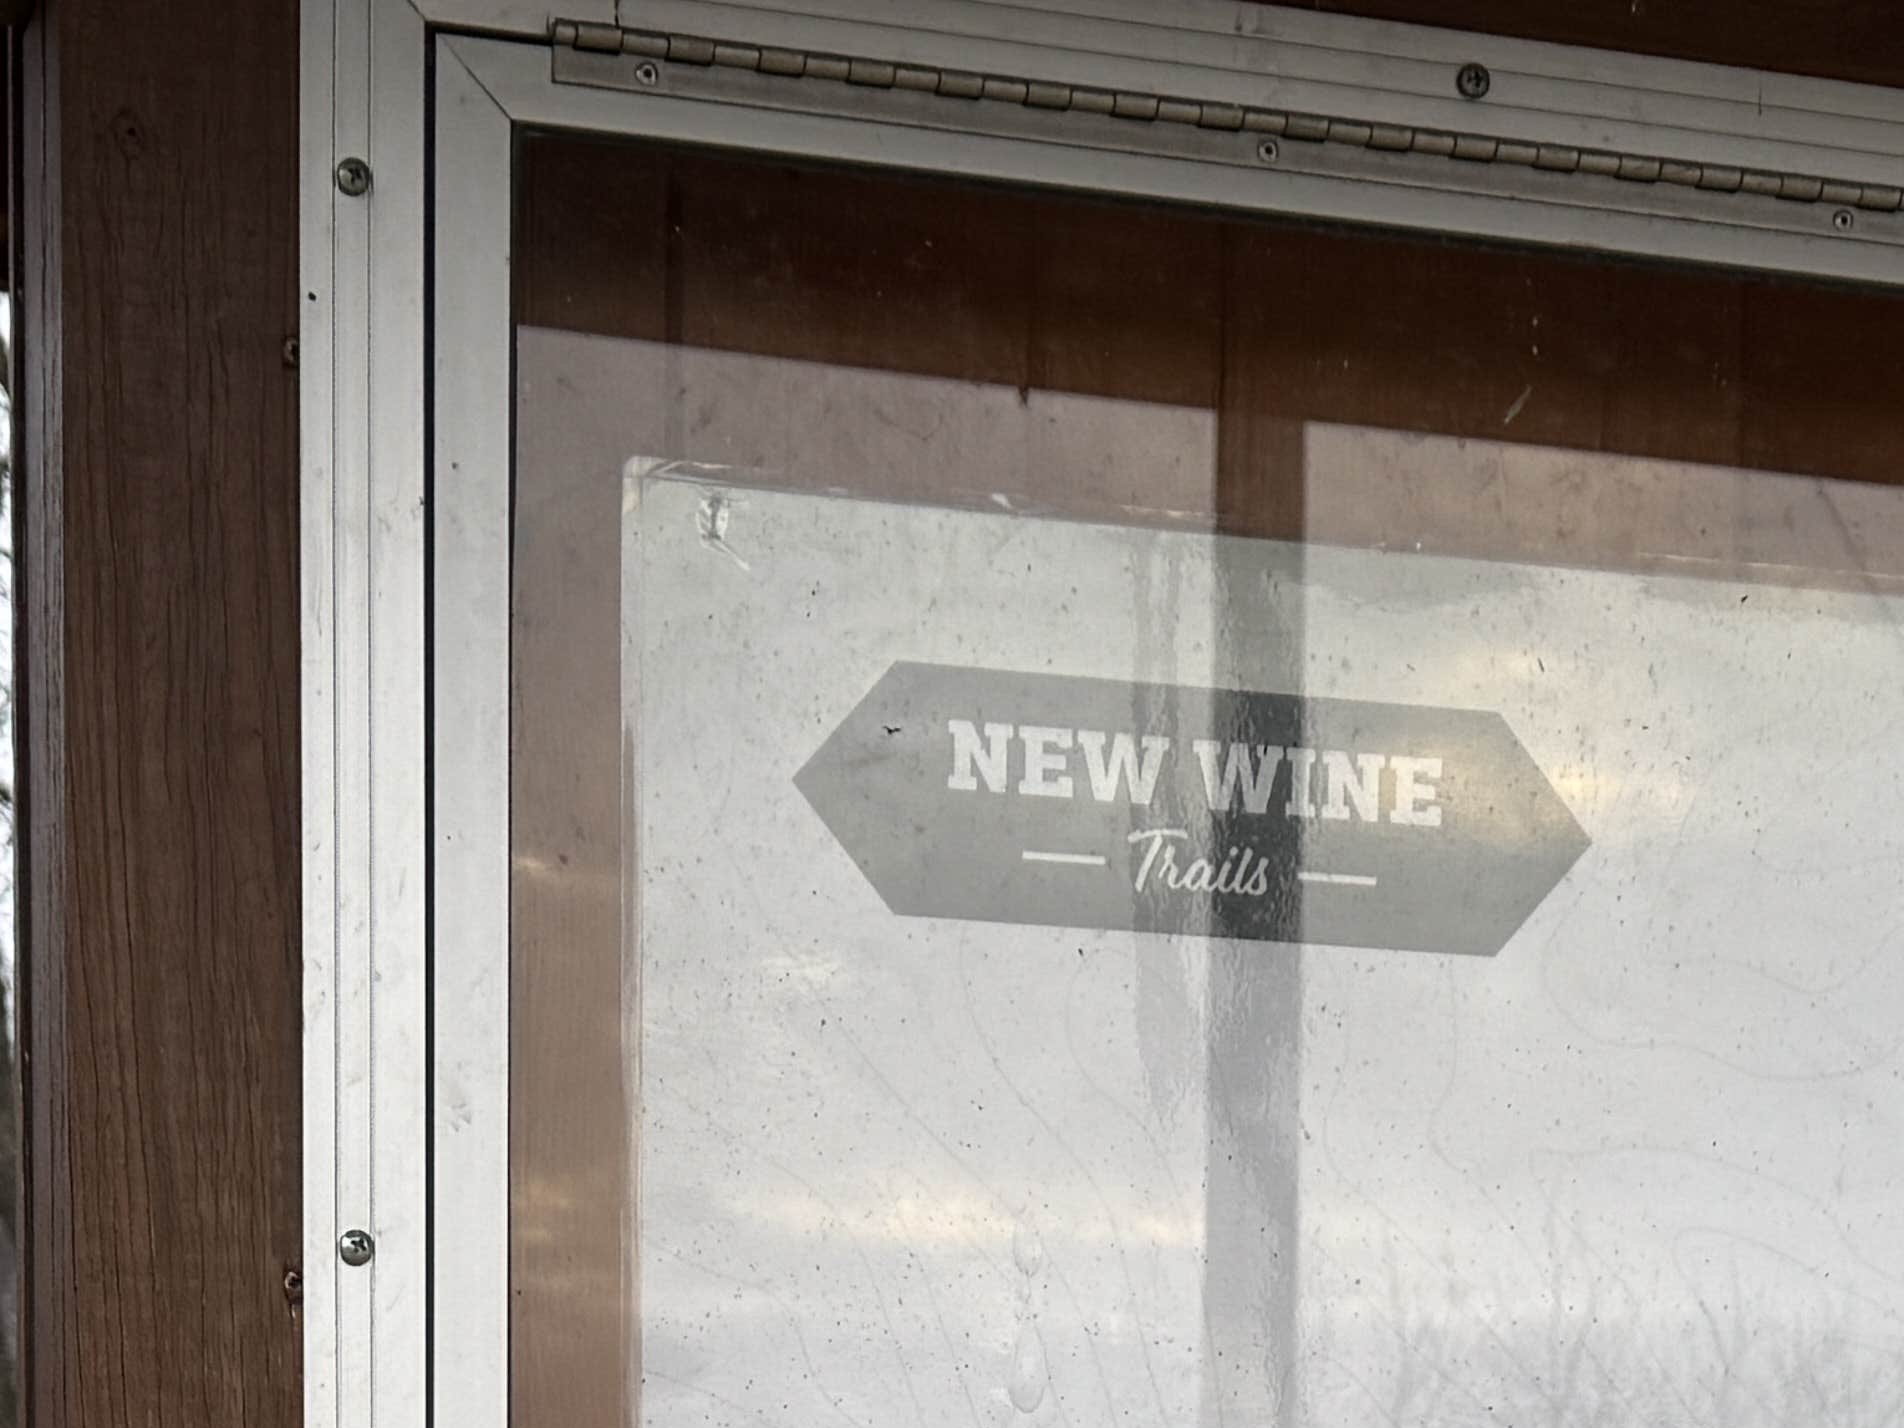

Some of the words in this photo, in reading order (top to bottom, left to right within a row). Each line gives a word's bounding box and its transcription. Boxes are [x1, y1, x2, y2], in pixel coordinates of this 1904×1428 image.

[947, 718, 1171, 805] NEW
[1194, 738, 1443, 826] WINE
[1128, 828, 1269, 895] Trails
